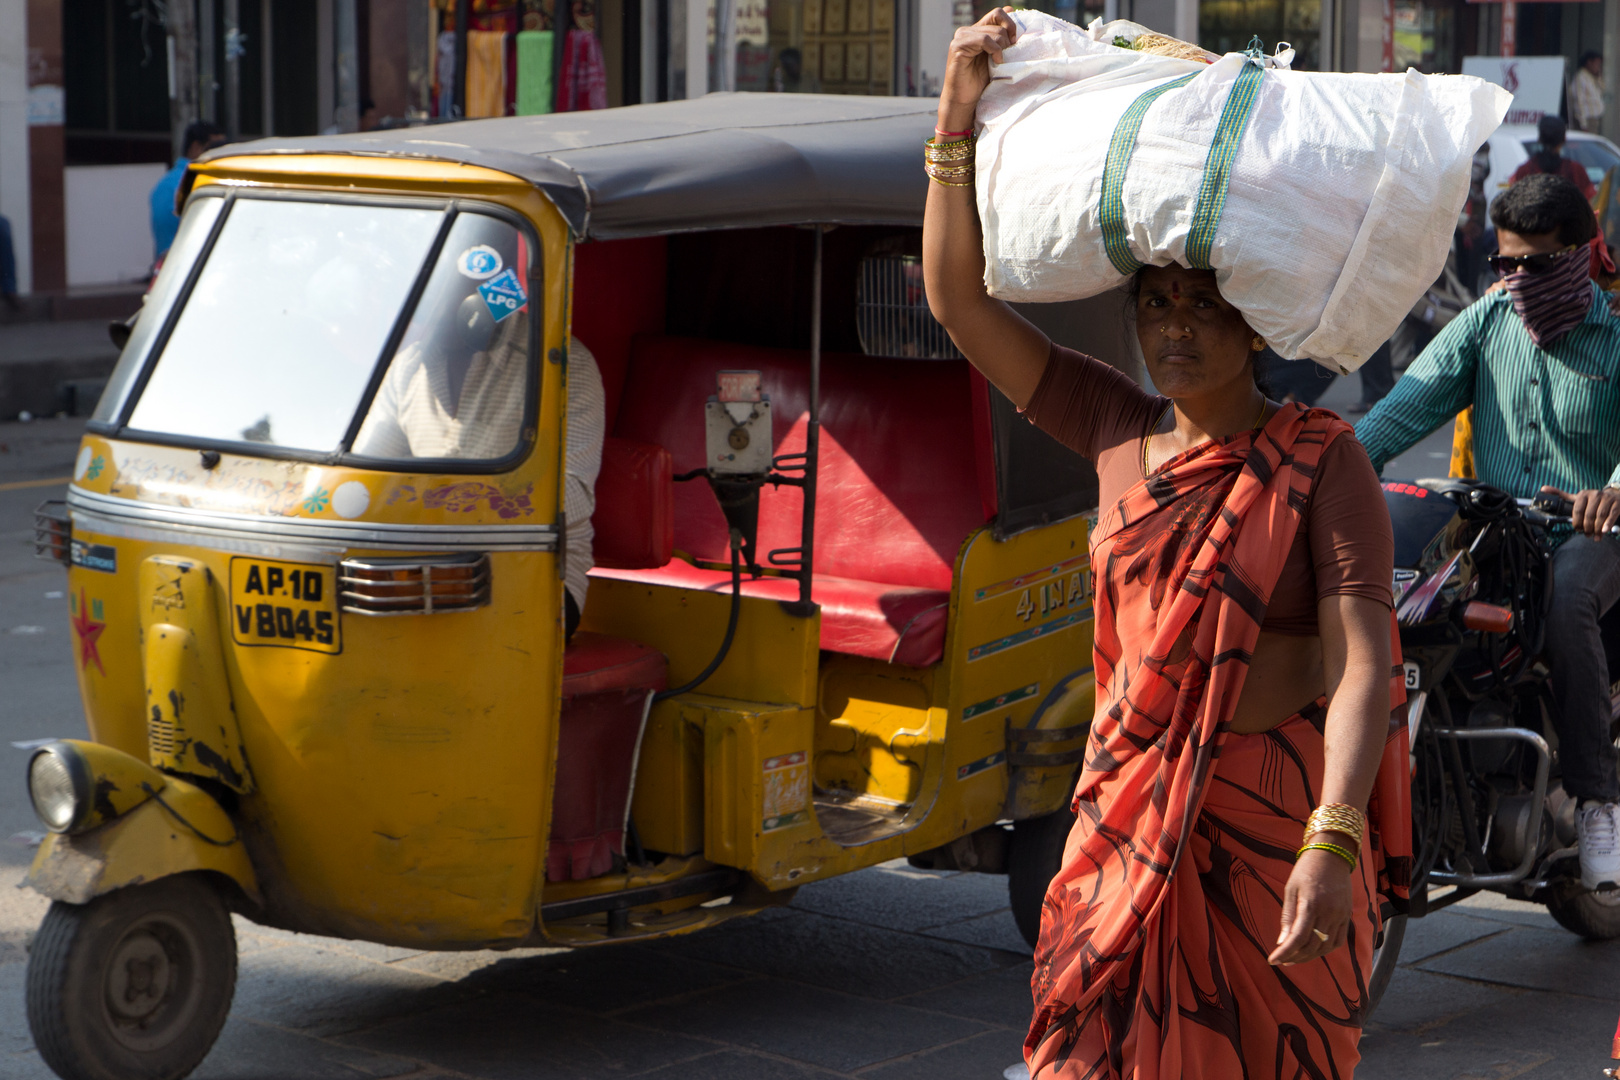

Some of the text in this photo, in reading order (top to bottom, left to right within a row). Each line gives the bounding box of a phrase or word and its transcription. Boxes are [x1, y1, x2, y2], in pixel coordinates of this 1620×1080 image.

[487, 292, 517, 309] LPG
[1380, 483, 1428, 498] RESS
[1016, 589, 1037, 622] 4
